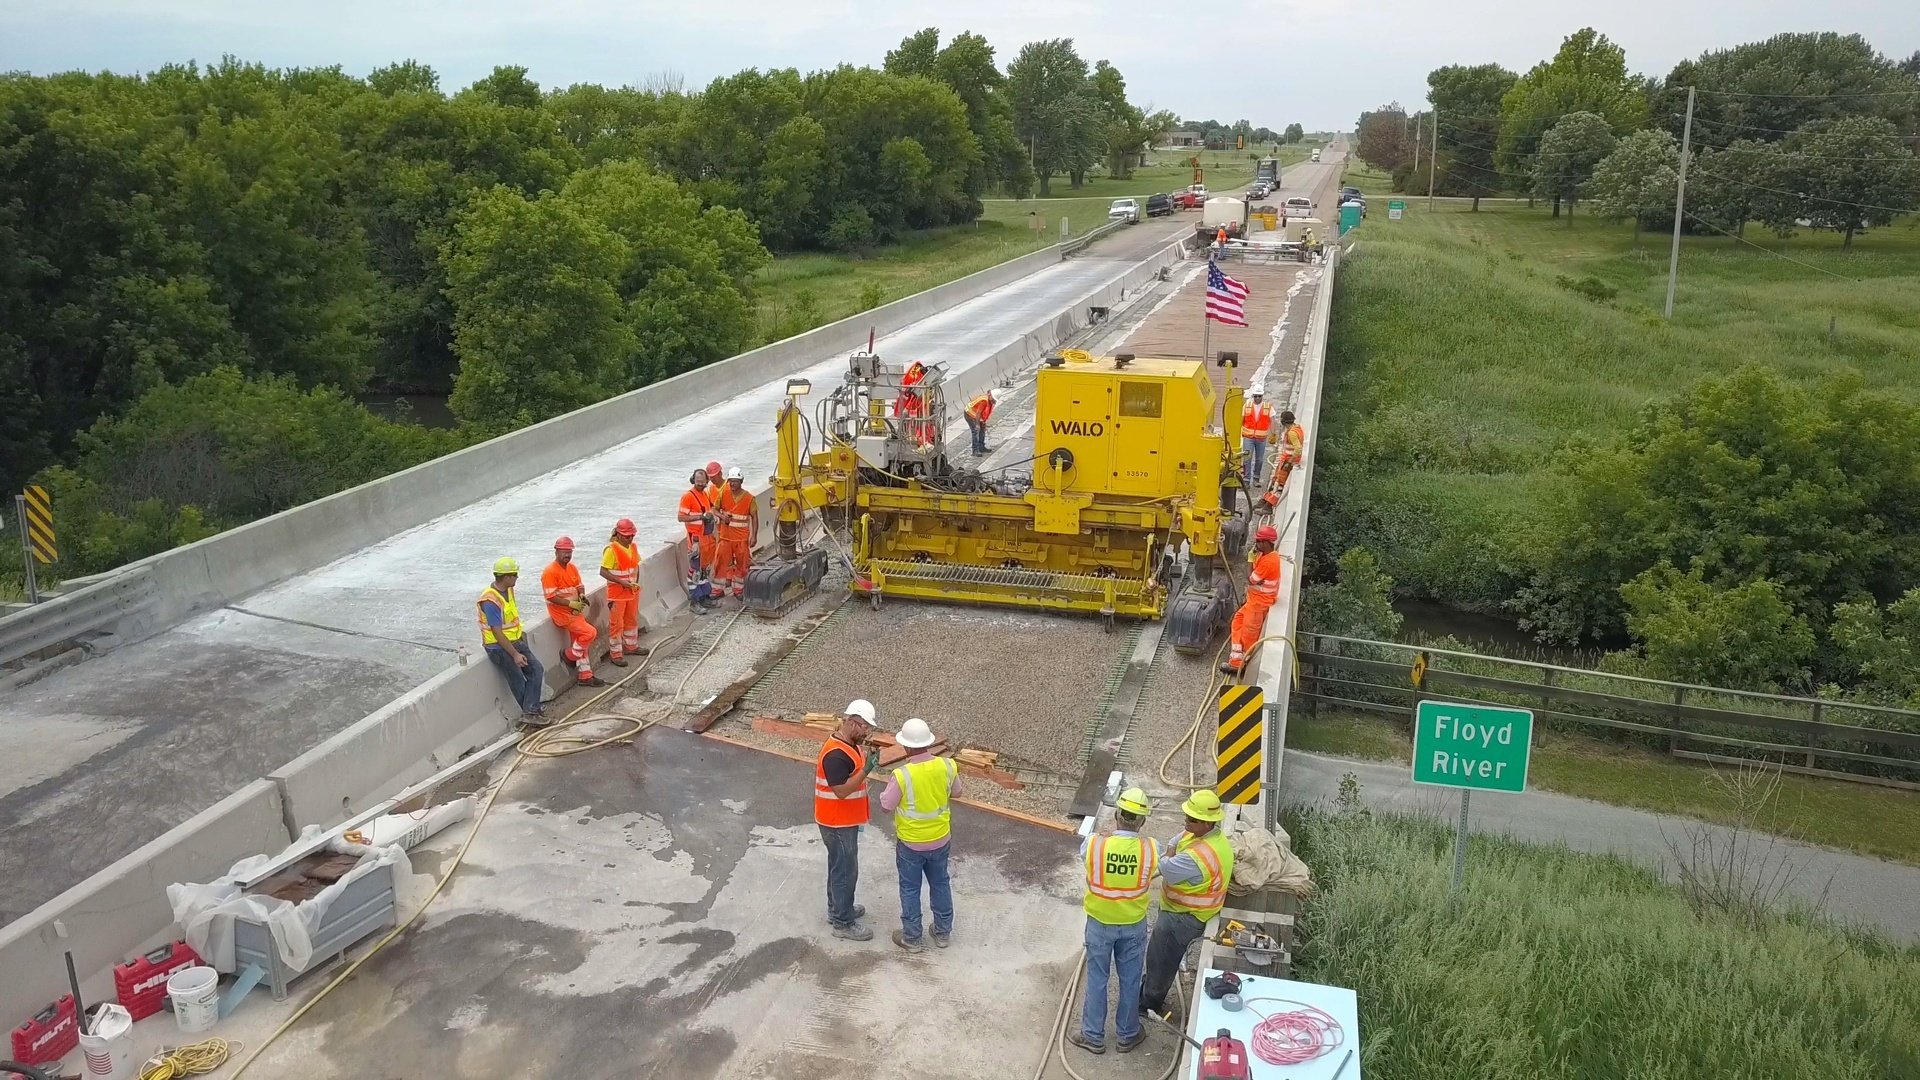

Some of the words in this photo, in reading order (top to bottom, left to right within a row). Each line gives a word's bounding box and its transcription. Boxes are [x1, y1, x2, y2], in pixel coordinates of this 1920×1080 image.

[1050, 420, 1104, 437] WALO
[1435, 715, 1512, 749] Floyd
[1432, 750, 1507, 779] River
[1106, 852, 1138, 864] IOWA
[1105, 862, 1138, 876] DOT
